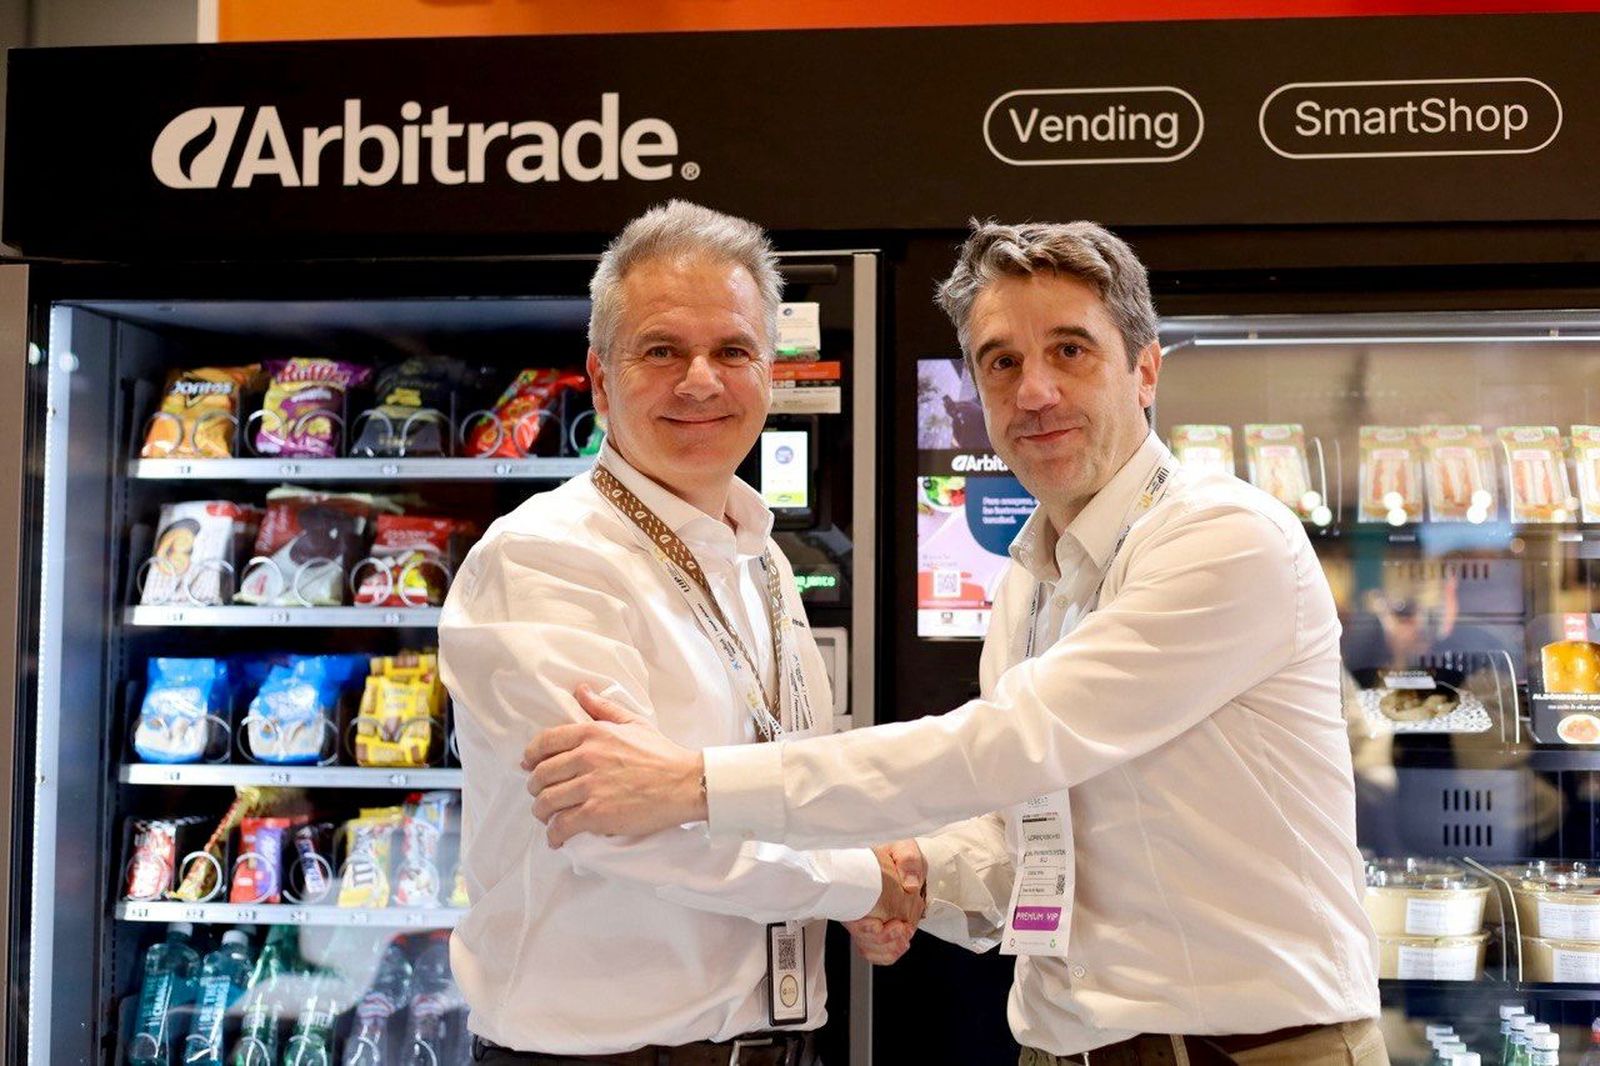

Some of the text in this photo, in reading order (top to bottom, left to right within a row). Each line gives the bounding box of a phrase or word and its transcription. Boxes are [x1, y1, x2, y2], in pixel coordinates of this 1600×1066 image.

[231, 92, 679, 188] Arbitrade
[1009, 104, 1180, 149] Vending
[1294, 97, 1529, 139] SmartShop
